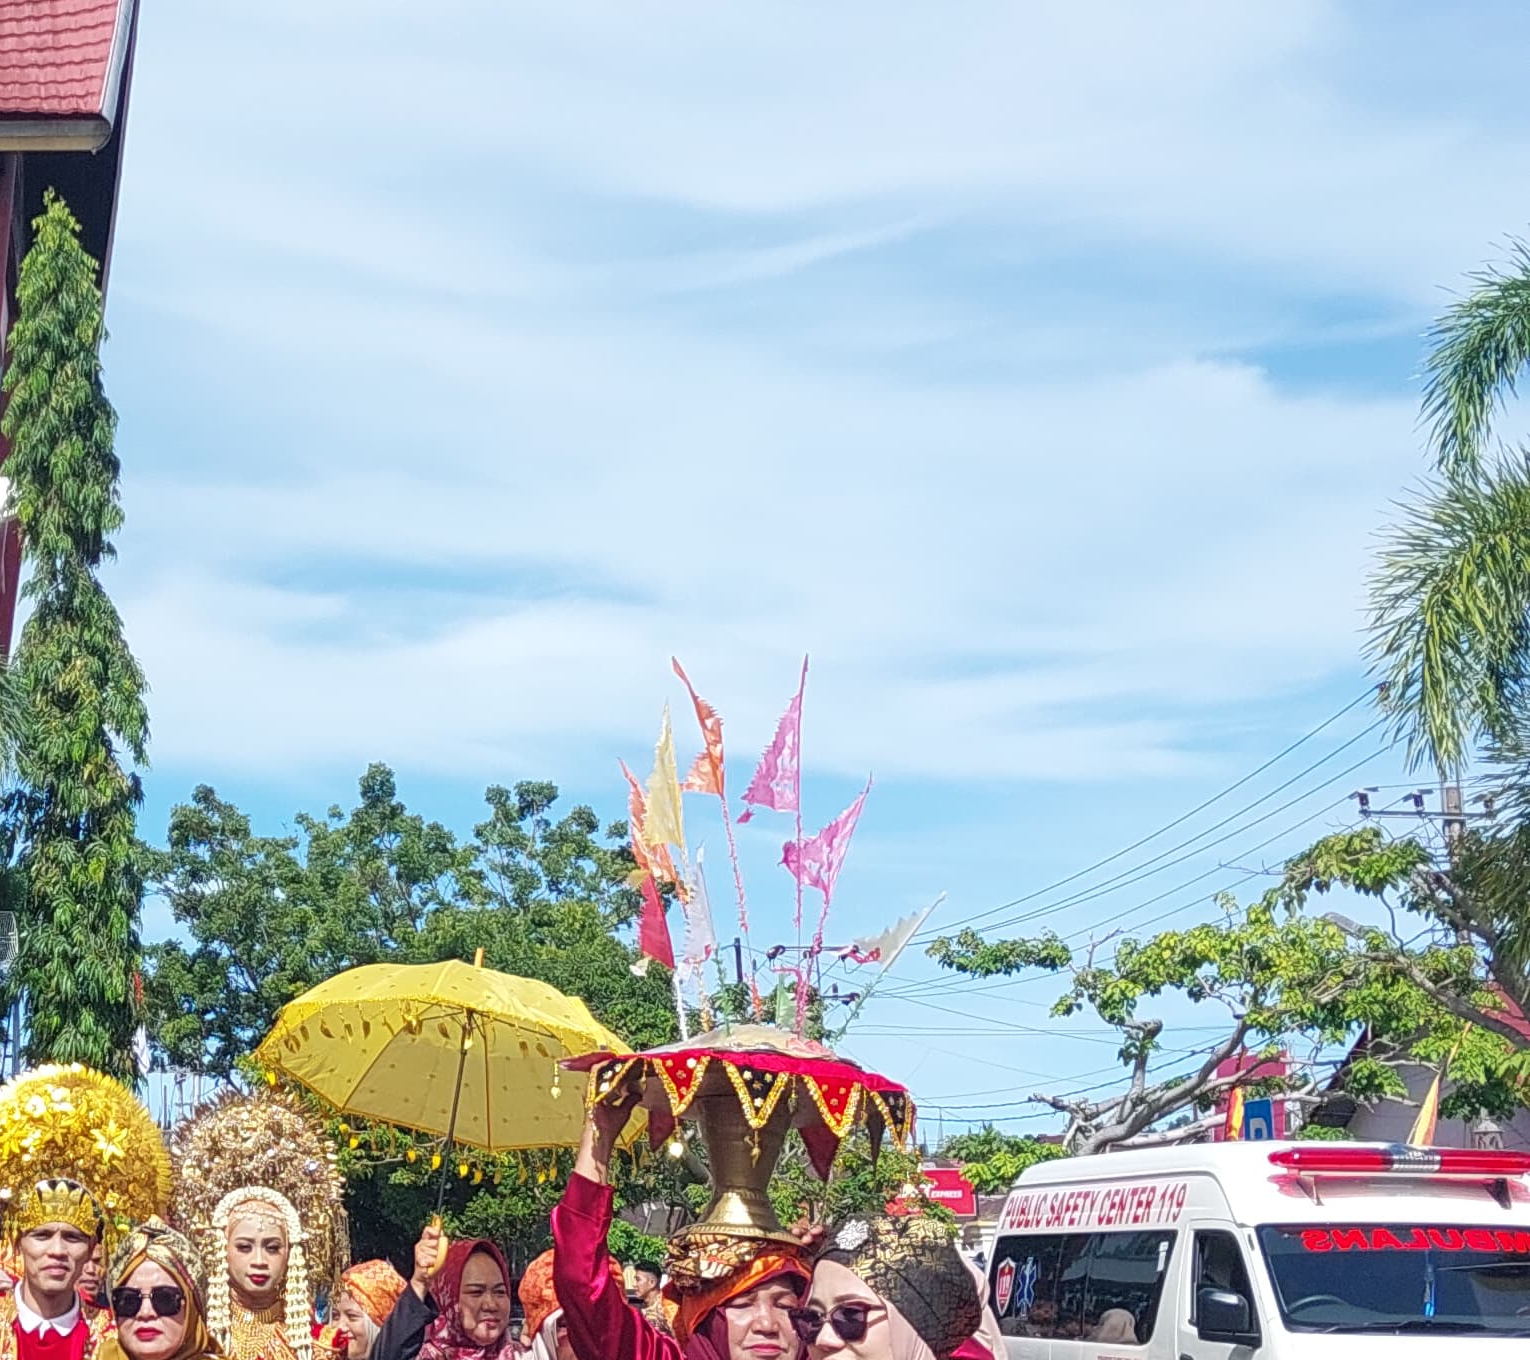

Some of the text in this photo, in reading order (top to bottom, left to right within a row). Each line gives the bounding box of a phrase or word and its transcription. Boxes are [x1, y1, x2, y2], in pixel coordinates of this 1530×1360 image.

[1001, 1183, 1188, 1230] PUBLIC SAFETY CENTER 119
